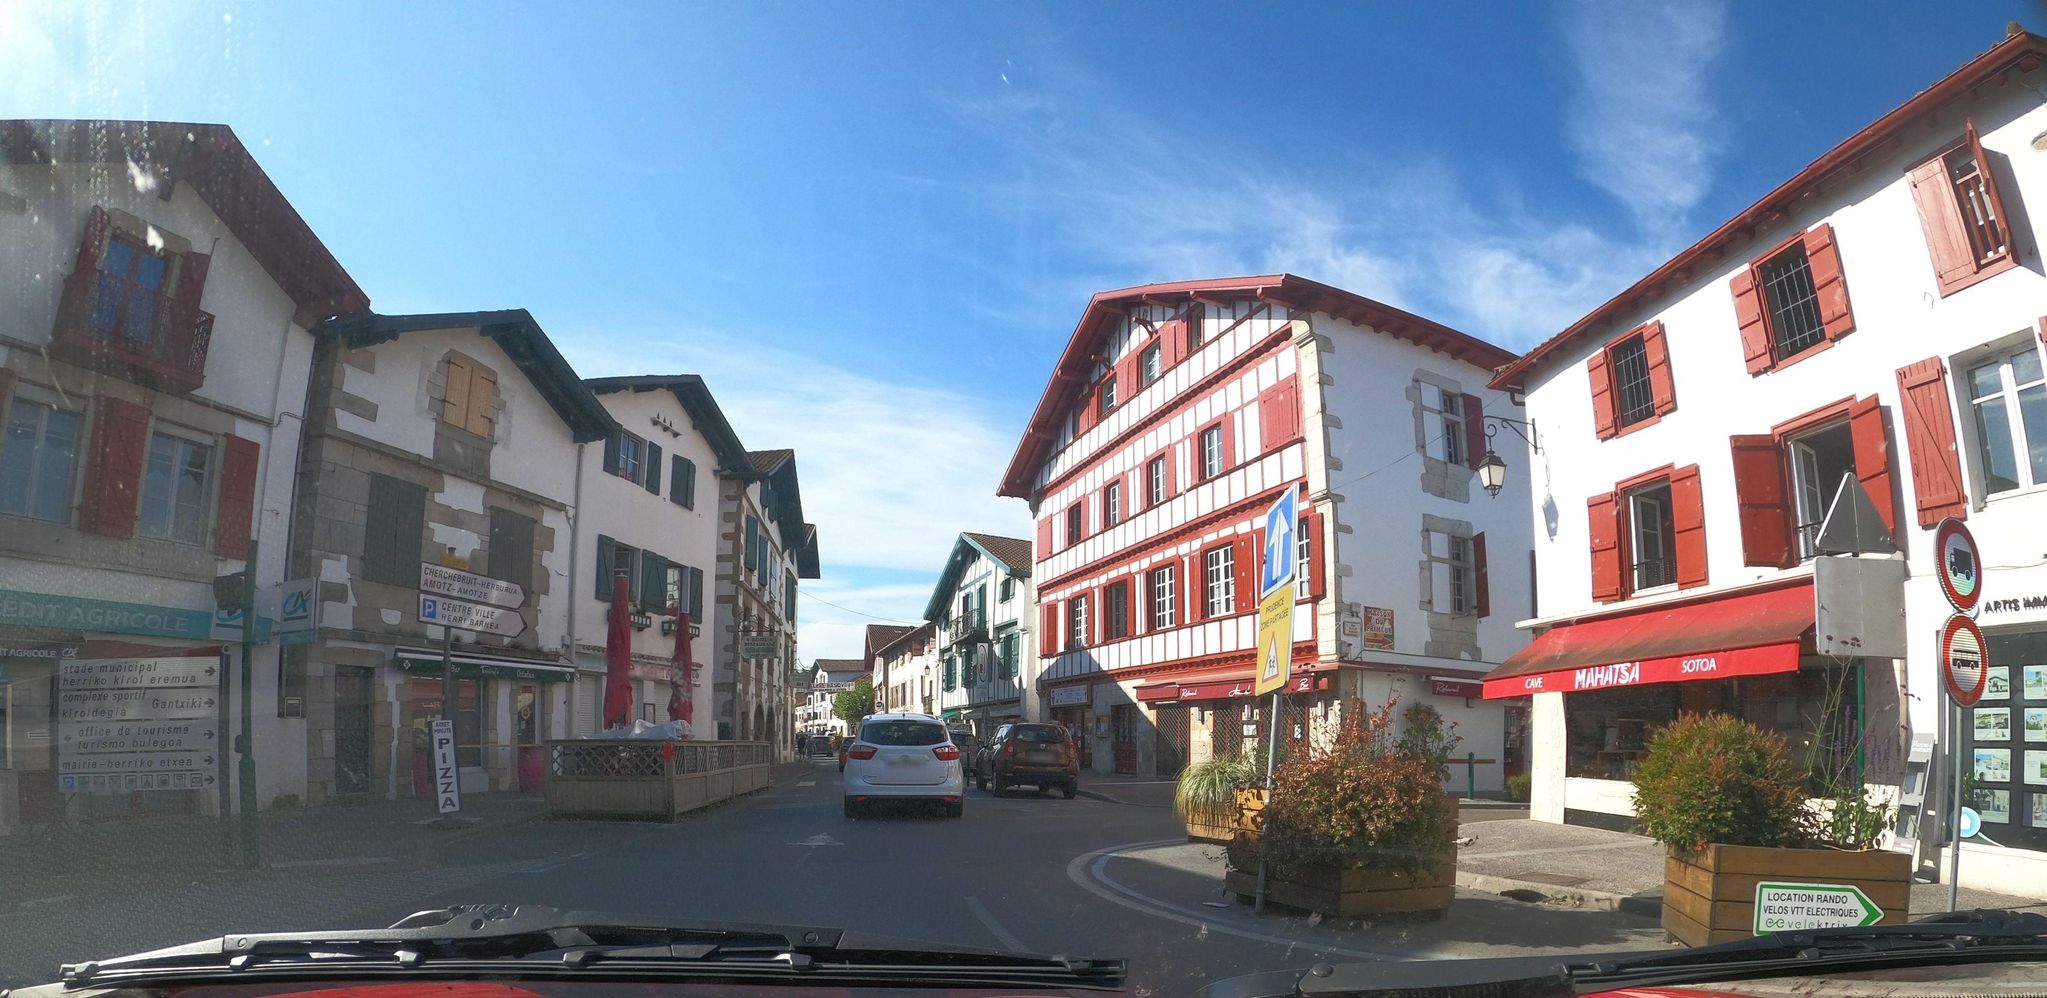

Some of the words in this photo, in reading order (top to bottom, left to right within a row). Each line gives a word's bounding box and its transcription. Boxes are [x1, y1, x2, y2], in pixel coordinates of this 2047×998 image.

[423, 566, 518, 595] CHERCHEBRUIT-HERBURUA
[442, 602, 472, 616] CENTRE
[475, 608, 495, 620] VILLE
[1265, 596, 1285, 613] PRUDENCE
[1984, 598, 2021, 614] ARTIS
[68, 607, 189, 632] AGRICOLE
[9, 648, 57, 658] AGRICOLE
[63, 663, 94, 674] stade
[100, 662, 158, 676] municipal
[1574, 661, 1640, 689] MAHATSA
[1681, 658, 1717, 674] SOTOA
[62, 675, 107, 686] herriko
[114, 674, 144, 685] kirol
[150, 676, 197, 685] eremua
[1525, 677, 1544, 689] CAVE
[62, 691, 109, 704] complexe
[112, 689, 147, 704] sportif
[151, 698, 203, 710] Gantxiki
[62, 706, 127, 719] kiroldegia
[78, 726, 111, 738] office
[118, 726, 131, 736] de
[137, 725, 189, 736] tourisme
[77, 739, 125, 750] turismo
[132, 738, 183, 750] bulegoa
[159, 757, 193, 767] etxea
[438, 737, 456, 809] PIZZA
[1767, 892, 1814, 903] LOCATION
[1816, 894, 1848, 905] RANDO
[1763, 905, 1789, 915] VELOS
[1791, 906, 1805, 916] VTT
[1806, 907, 1859, 918] ELECTRIQUES
[1788, 920, 1848, 929] velektrix
